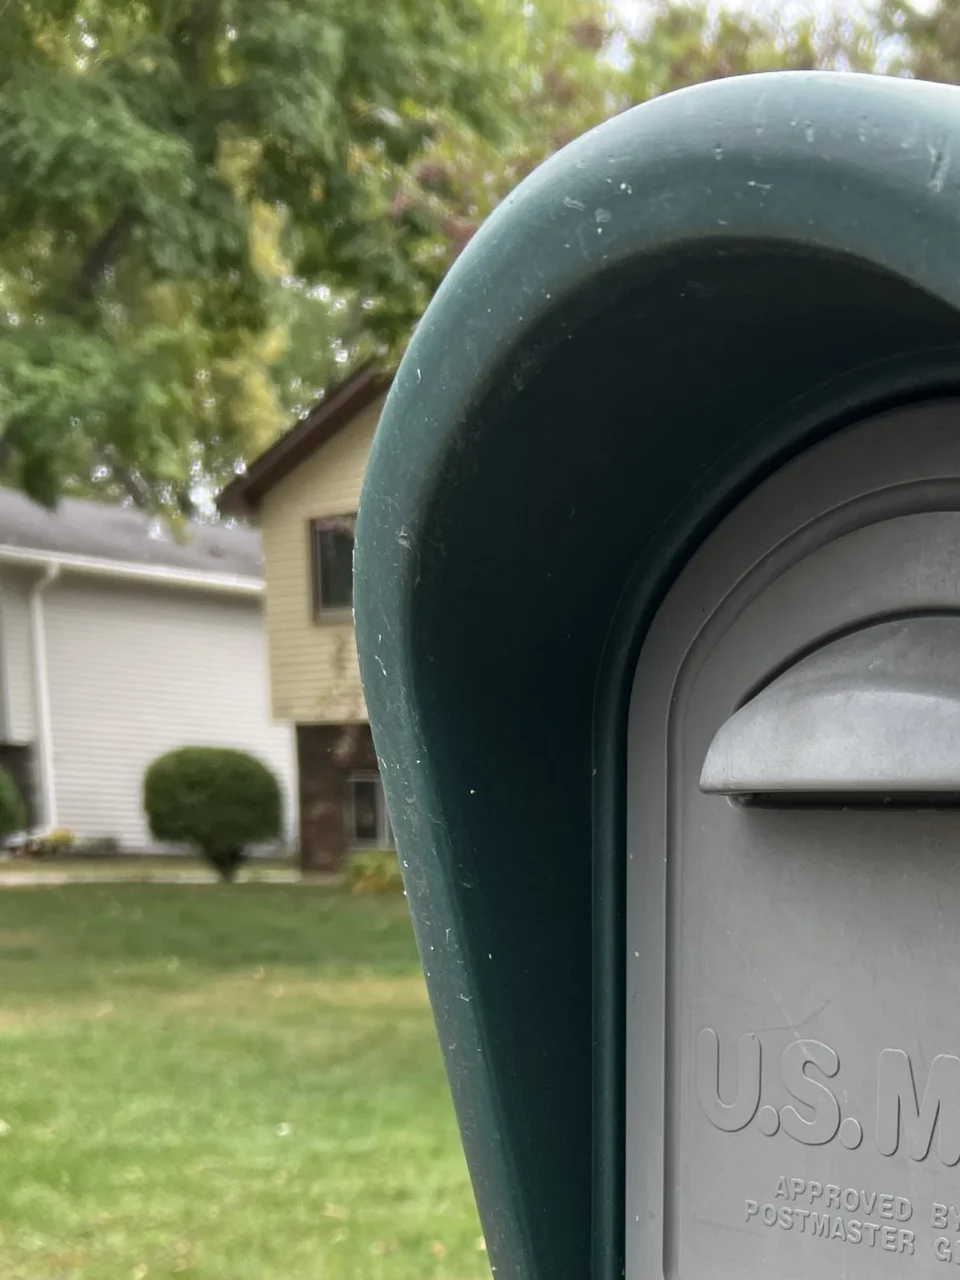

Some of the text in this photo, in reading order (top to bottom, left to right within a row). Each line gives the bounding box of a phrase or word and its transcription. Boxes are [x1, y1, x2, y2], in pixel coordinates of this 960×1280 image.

[697, 1026, 863, 1150] U.S.
[774, 1175, 914, 1222] APPROVED
[745, 1199, 916, 1255] POSTMASTER
